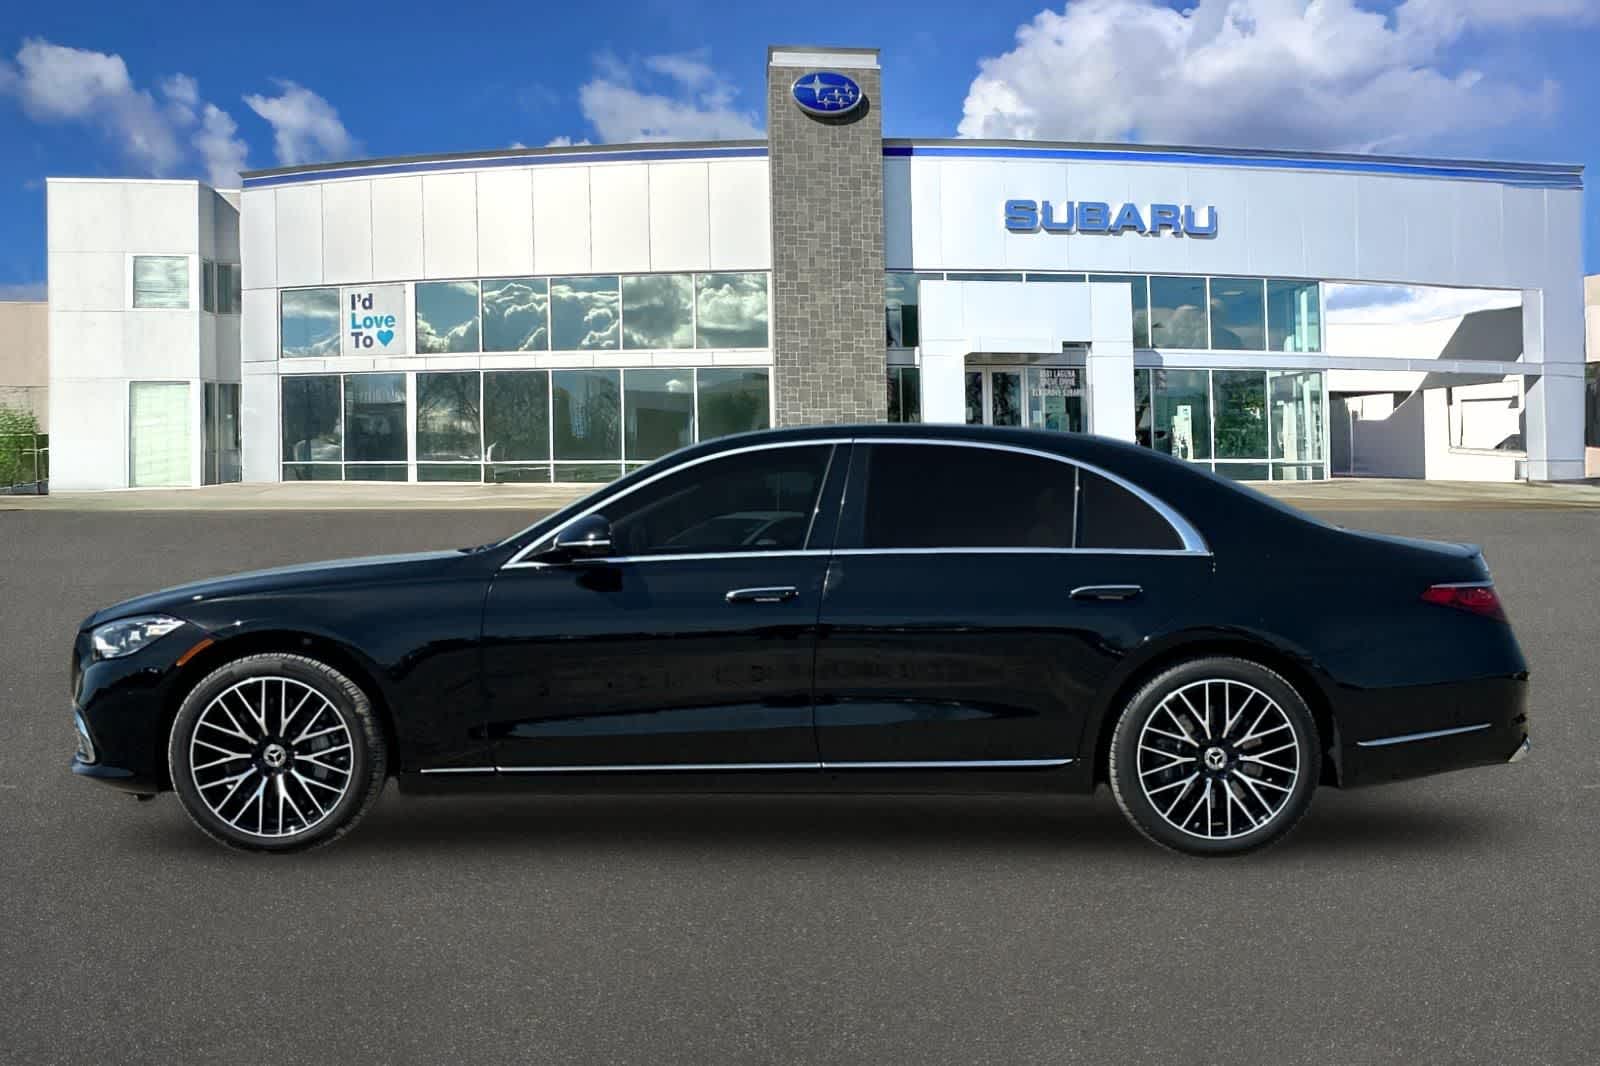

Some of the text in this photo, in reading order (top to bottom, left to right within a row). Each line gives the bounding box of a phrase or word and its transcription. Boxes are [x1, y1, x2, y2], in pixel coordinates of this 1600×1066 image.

[1005, 199, 1217, 236] SUBARU
[351, 293, 373, 310] I'd
[351, 313, 396, 329] Love
[351, 331, 374, 348] To
